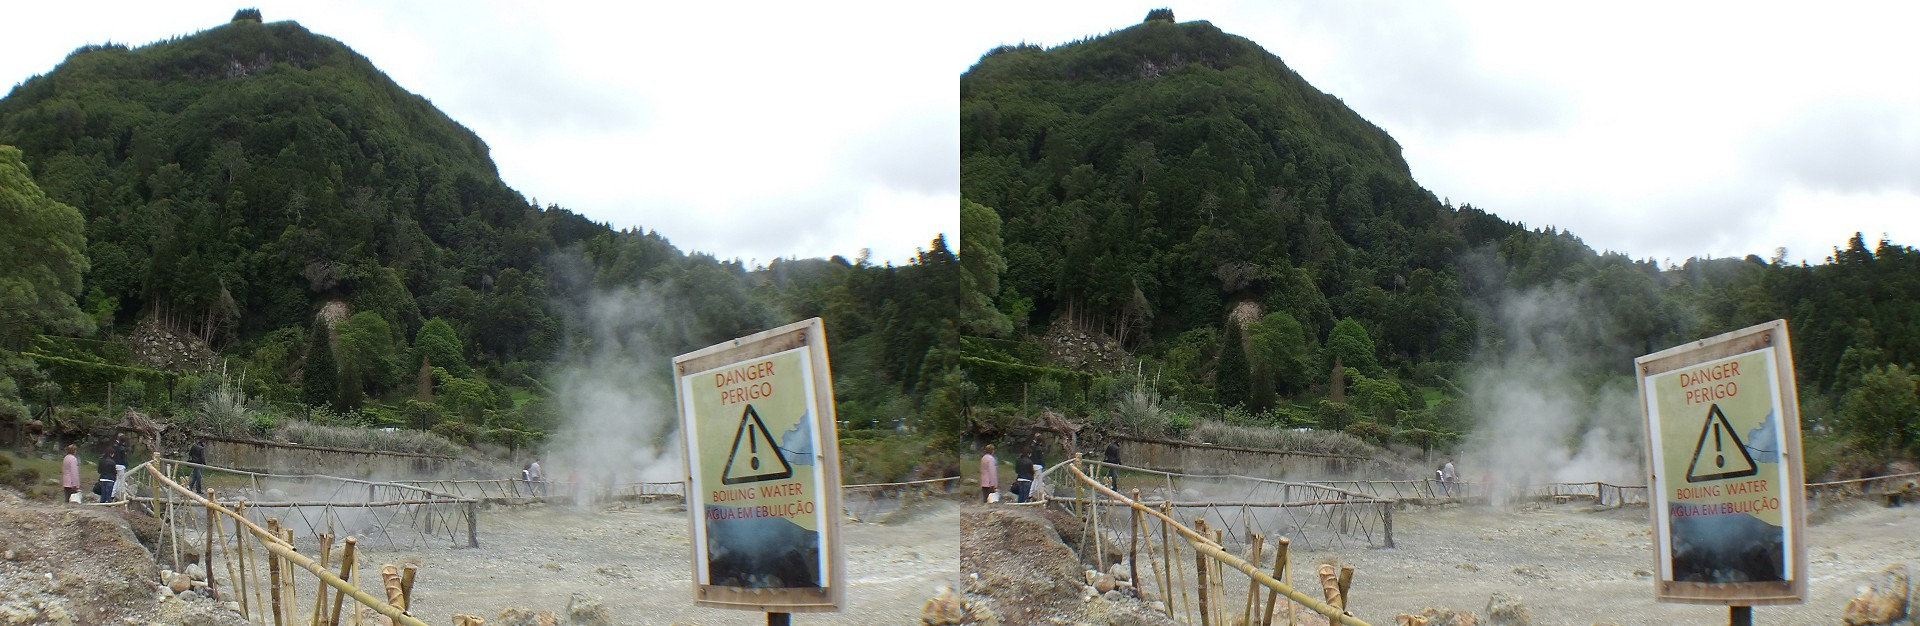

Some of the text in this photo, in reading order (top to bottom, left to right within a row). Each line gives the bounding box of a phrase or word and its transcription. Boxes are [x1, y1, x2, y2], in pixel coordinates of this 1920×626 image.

[715, 360, 775, 388] DANGER
[1680, 361, 1741, 388] DANGER
[721, 381, 773, 405] PERIGO
[1686, 381, 1737, 405] PERIGO
[713, 482, 803, 502] BOILING WATER
[1677, 479, 1768, 500] BOILING WATER
[737, 505, 754, 518] EM
[755, 499, 815, 518] EBULIÇÃO
[1702, 503, 1718, 516] EM
[1721, 496, 1779, 515] EBULIÇÃO
